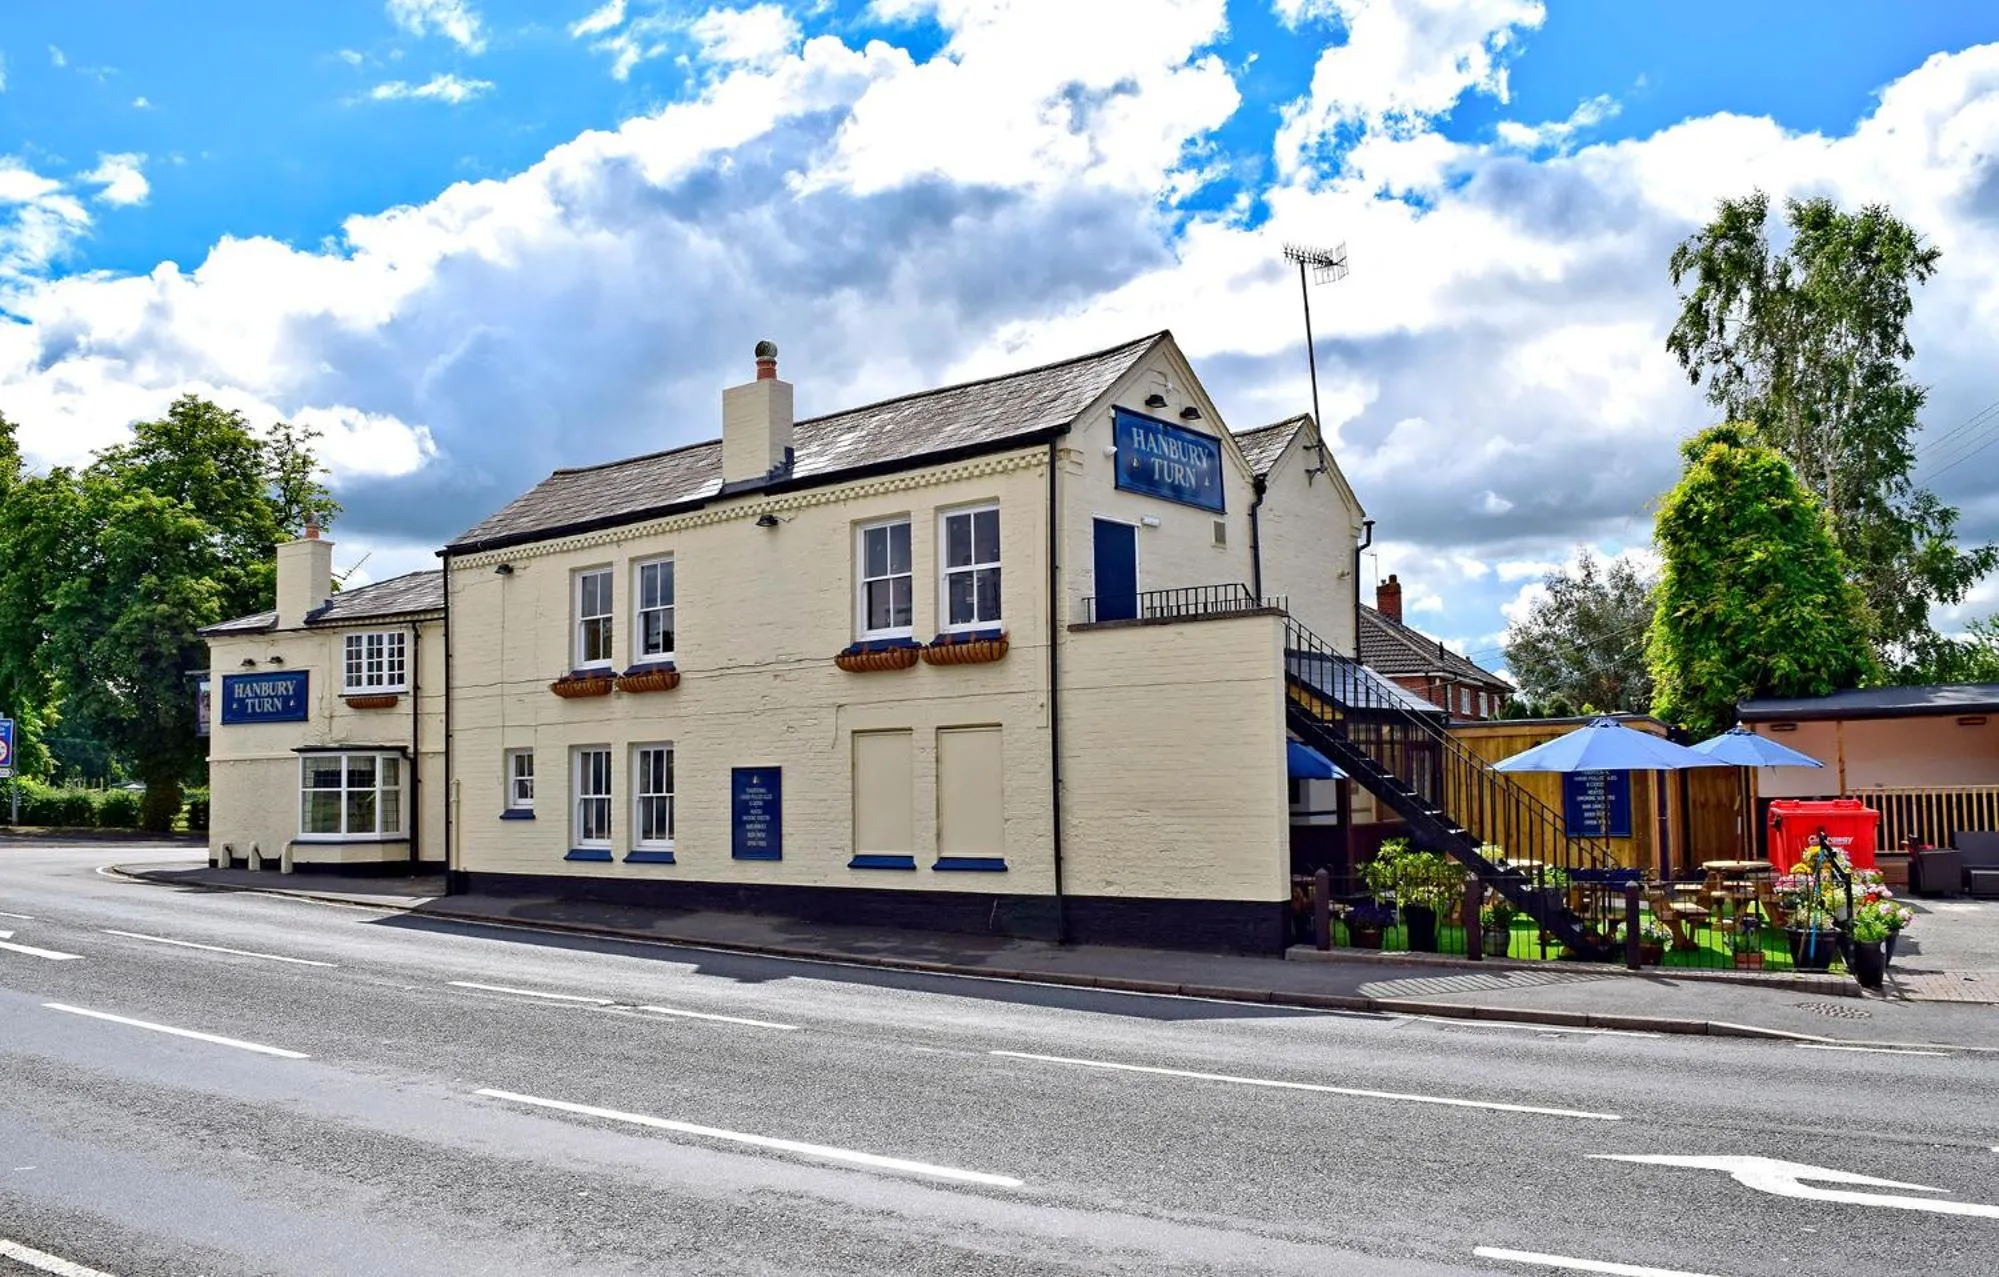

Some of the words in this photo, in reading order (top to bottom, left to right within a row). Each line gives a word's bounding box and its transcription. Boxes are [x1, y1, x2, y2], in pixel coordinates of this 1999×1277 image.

[1132, 427, 1209, 469] HANBURY
[1151, 457, 1196, 489] TURN
[234, 680, 296, 698] HANBURY
[245, 698, 282, 713] TURN
